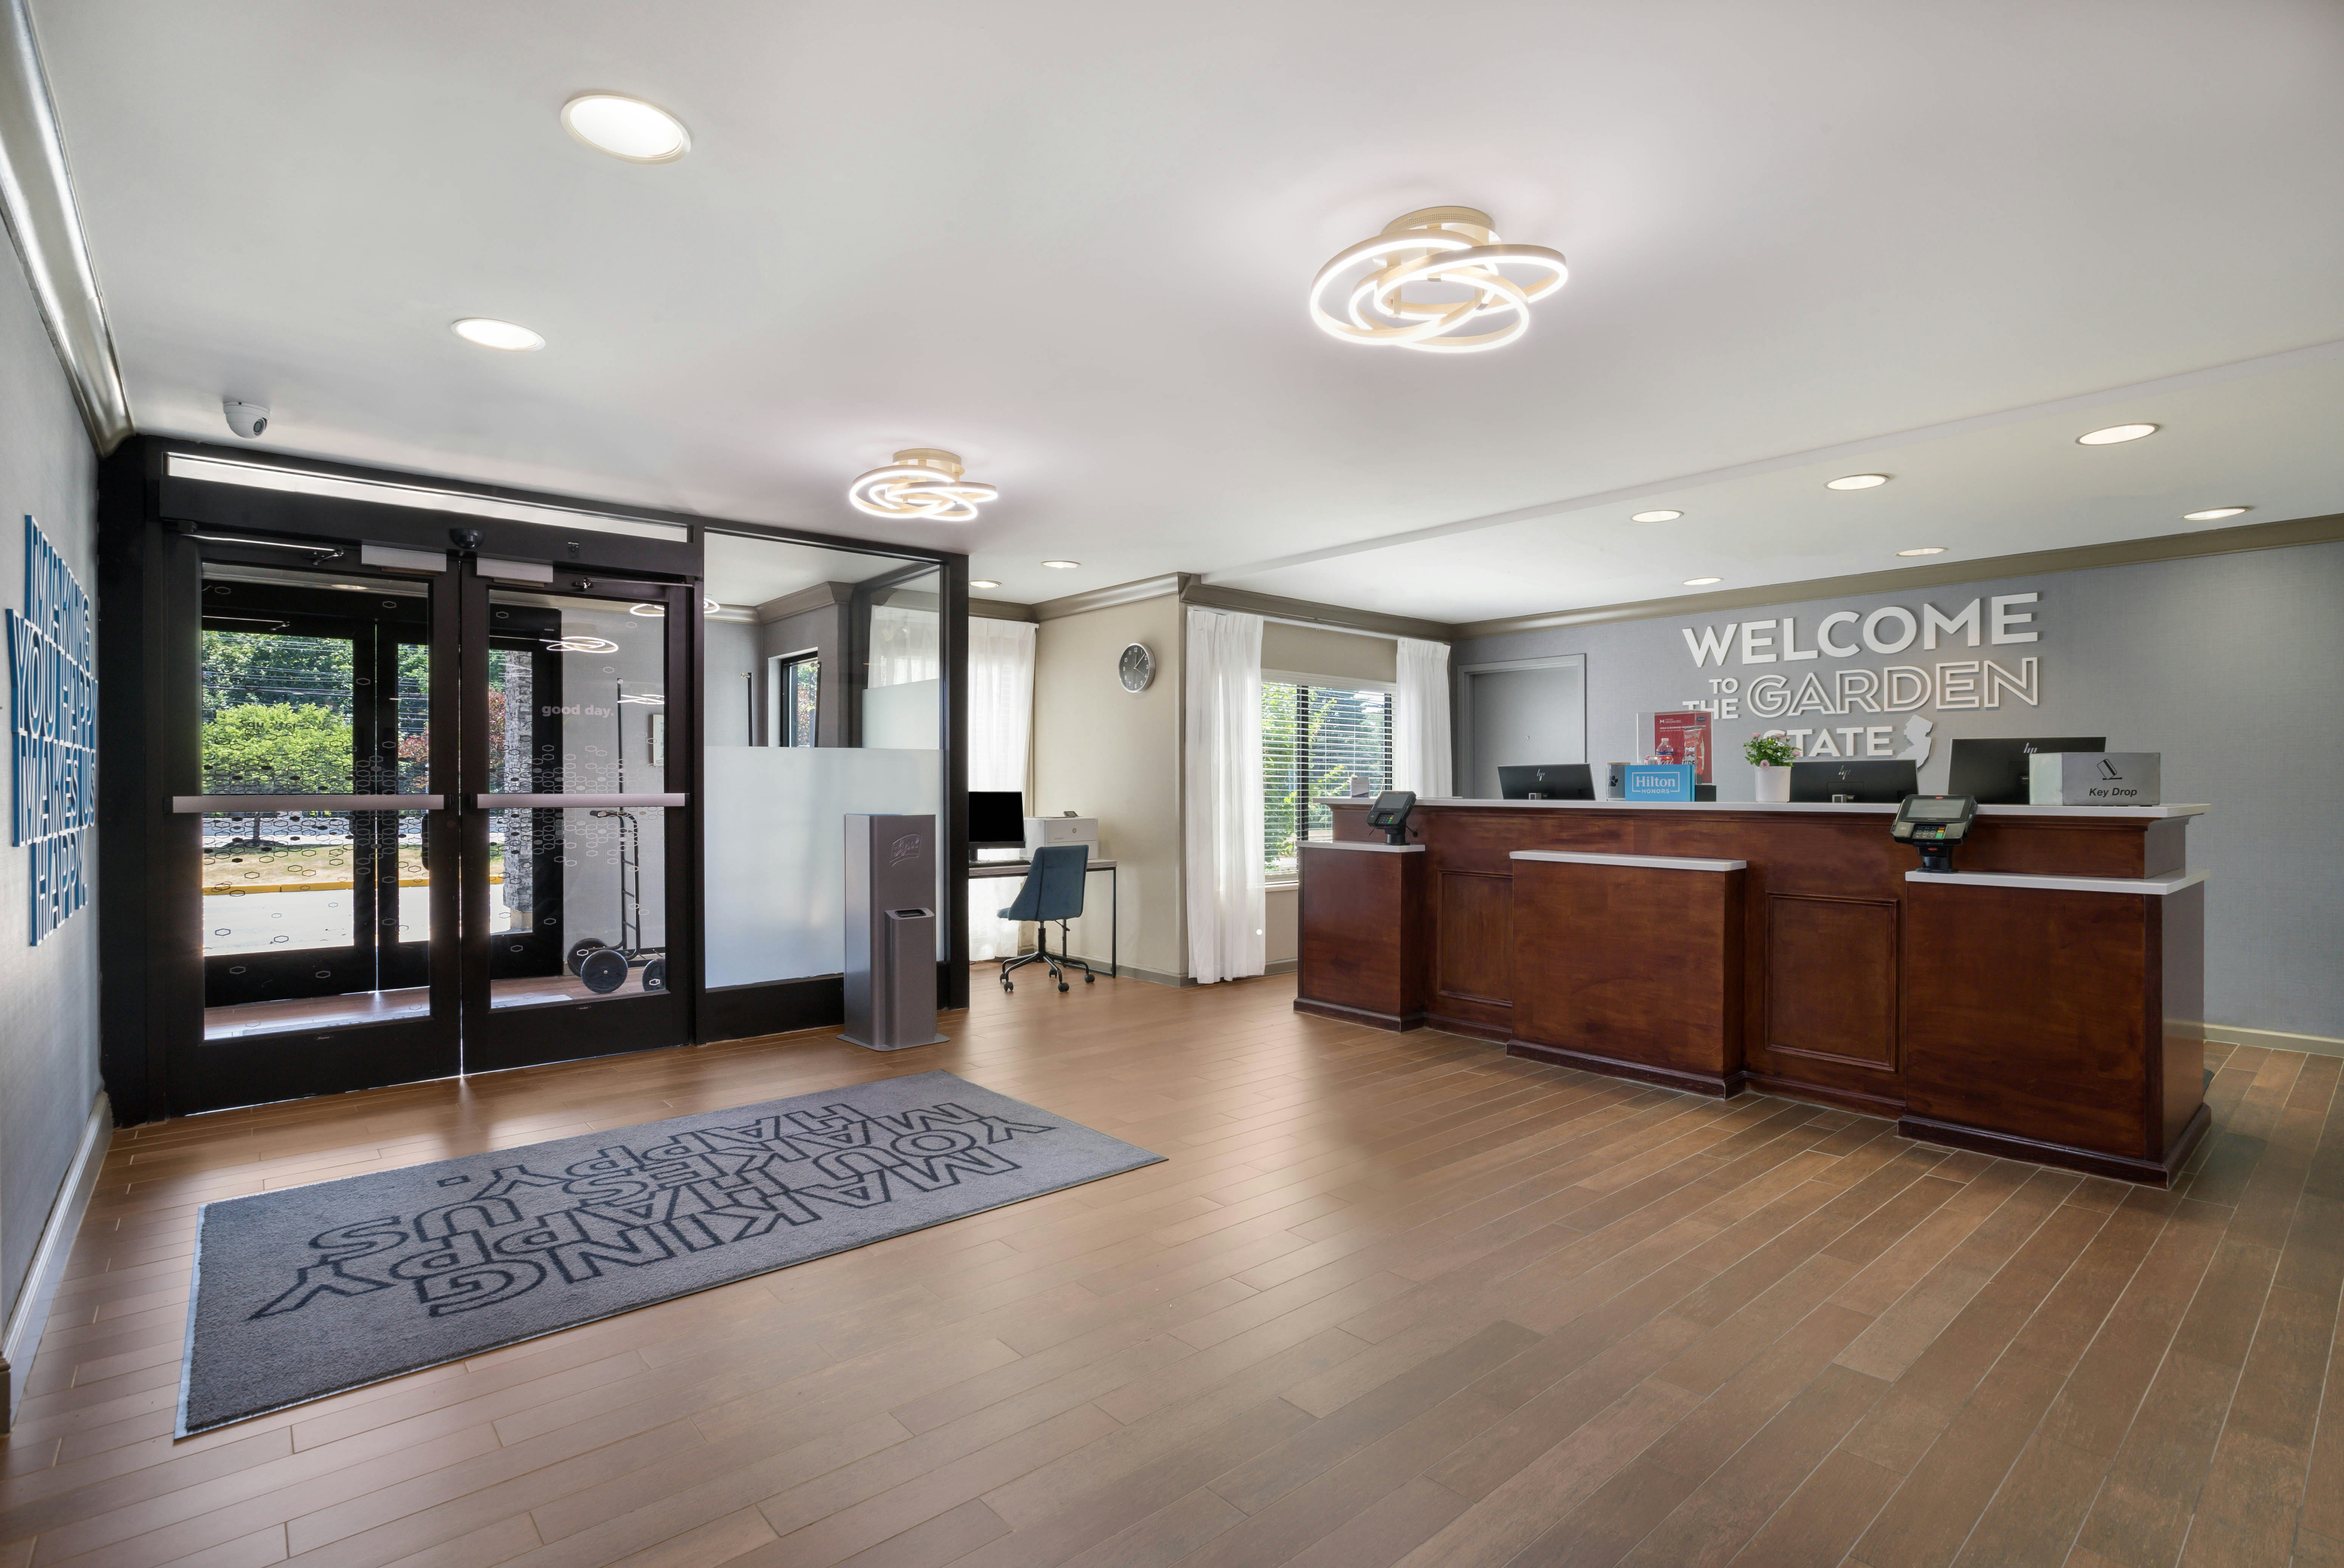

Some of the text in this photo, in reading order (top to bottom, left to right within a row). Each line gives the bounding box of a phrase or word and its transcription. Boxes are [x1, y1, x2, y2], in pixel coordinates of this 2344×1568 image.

[25, 515, 91, 676] MAKING
[1683, 592, 2038, 667] WELCOME
[6, 609, 98, 749] YOU HAPPY
[542, 704, 615, 718] good day.
[1683, 698, 1738, 719] THE
[1709, 678, 1738, 694] TO
[1747, 657, 2038, 718] GARDEN
[13, 729, 96, 846] MAKES US
[1536, 769, 1545, 781] hp
[1636, 776, 1676, 787] Hilton
[2089, 788, 2137, 797] Key Drop
[308, 1103, 986, 1263] MAKES US
[437, 1103, 875, 1201] HAPPY.
[247, 1115, 1059, 1321] YOU HAPPY
[414, 1146, 1023, 1317] MAKING
